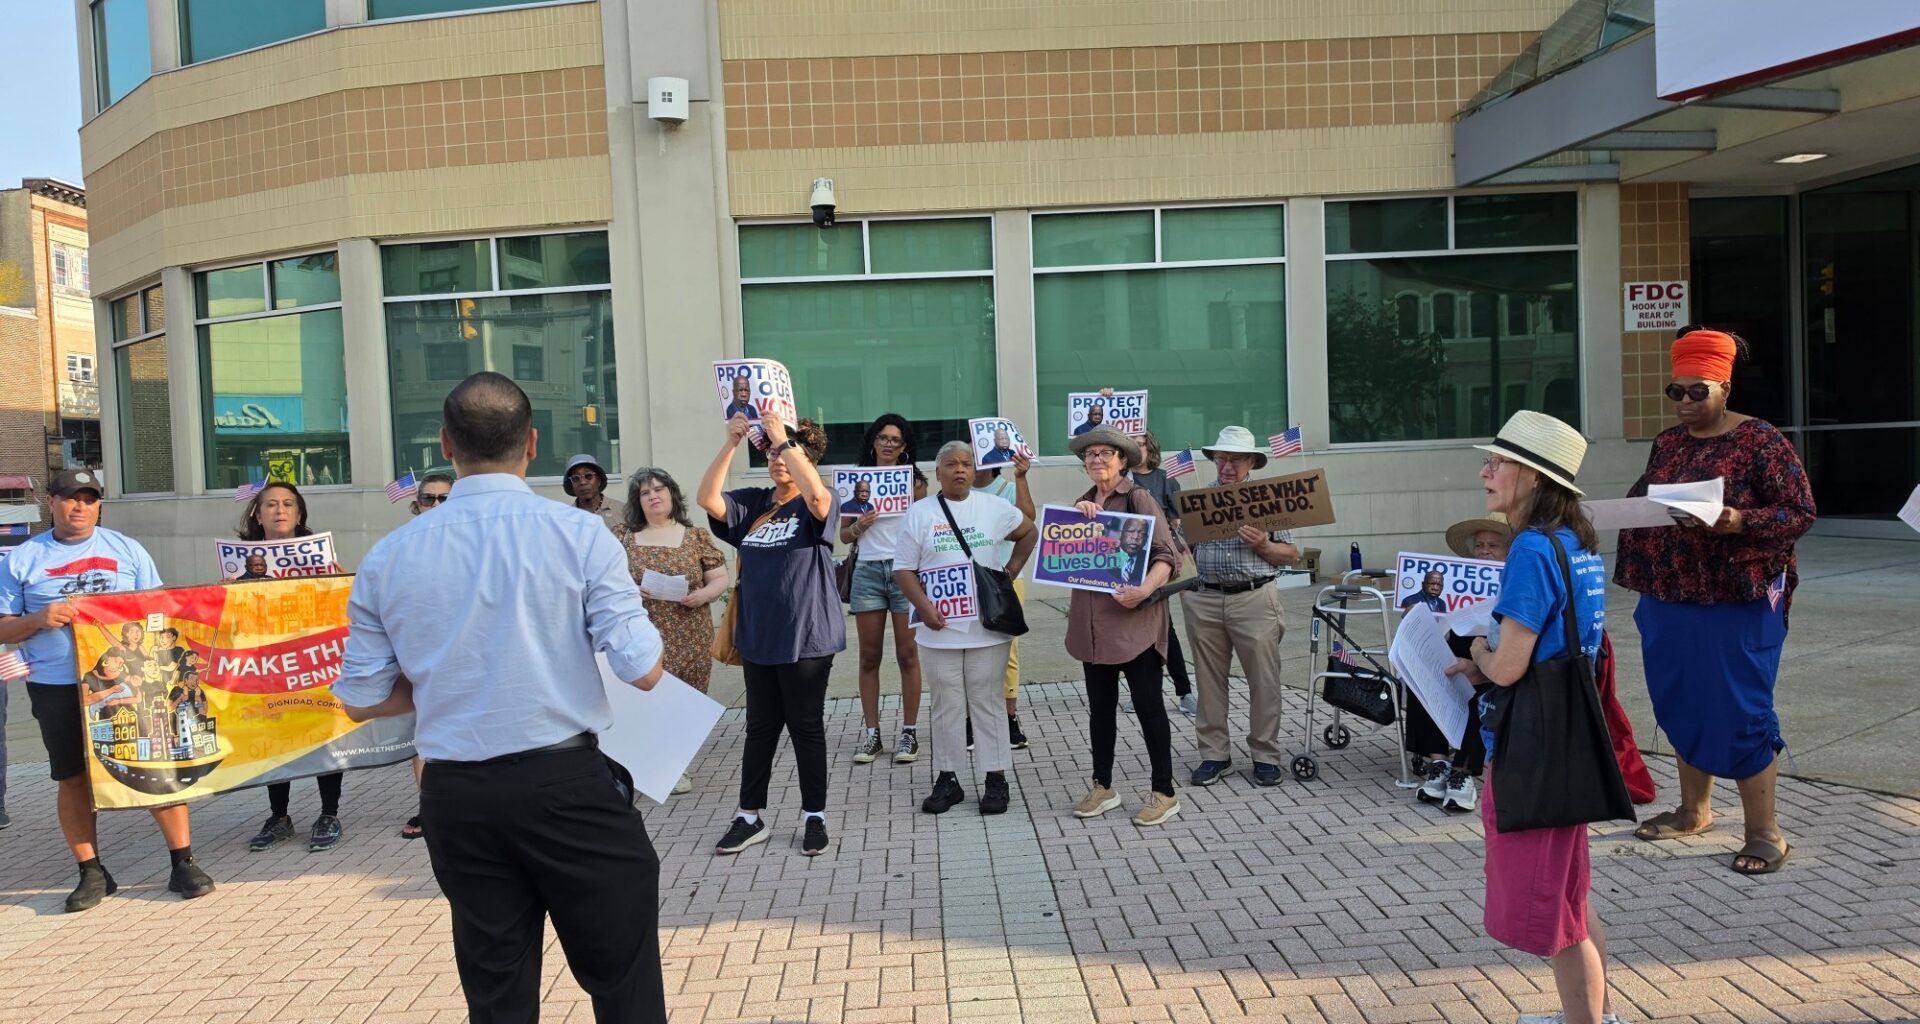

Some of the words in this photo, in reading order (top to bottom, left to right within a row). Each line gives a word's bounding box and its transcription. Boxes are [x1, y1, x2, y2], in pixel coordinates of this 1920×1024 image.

[1629, 283, 1684, 301] FDC
[1637, 320, 1677, 328] BUILDING
[759, 381, 792, 402] OUR
[1072, 396, 1144, 409] PROTECT
[1109, 407, 1141, 419] OUR
[837, 470, 910, 484] PROTECT
[877, 484, 907, 496] OUR
[1180, 493, 1207, 514] LET
[1212, 491, 1236, 508] US
[1238, 484, 1270, 504] SEE
[1270, 474, 1320, 499] WHAT
[873, 496, 911, 512] VOTE!
[1200, 506, 1244, 526] LOVE
[1248, 502, 1283, 518] CAN
[1285, 496, 1314, 513] DO.
[1048, 524, 1094, 540] Good
[222, 539, 326, 559] PROTECT
[1047, 538, 1109, 555] Trouble
[276, 554, 325, 567] OUR
[1047, 555, 1091, 570] Lives
[1093, 552, 1117, 568] On
[1403, 559, 1504, 581] PROTECT
[932, 582, 967, 598] OUR
[1452, 580, 1499, 596] OUR
[217, 651, 300, 676] MAKE
[286, 663, 341, 690] PENN
[267, 698, 314, 709] DIGNIDAD,
